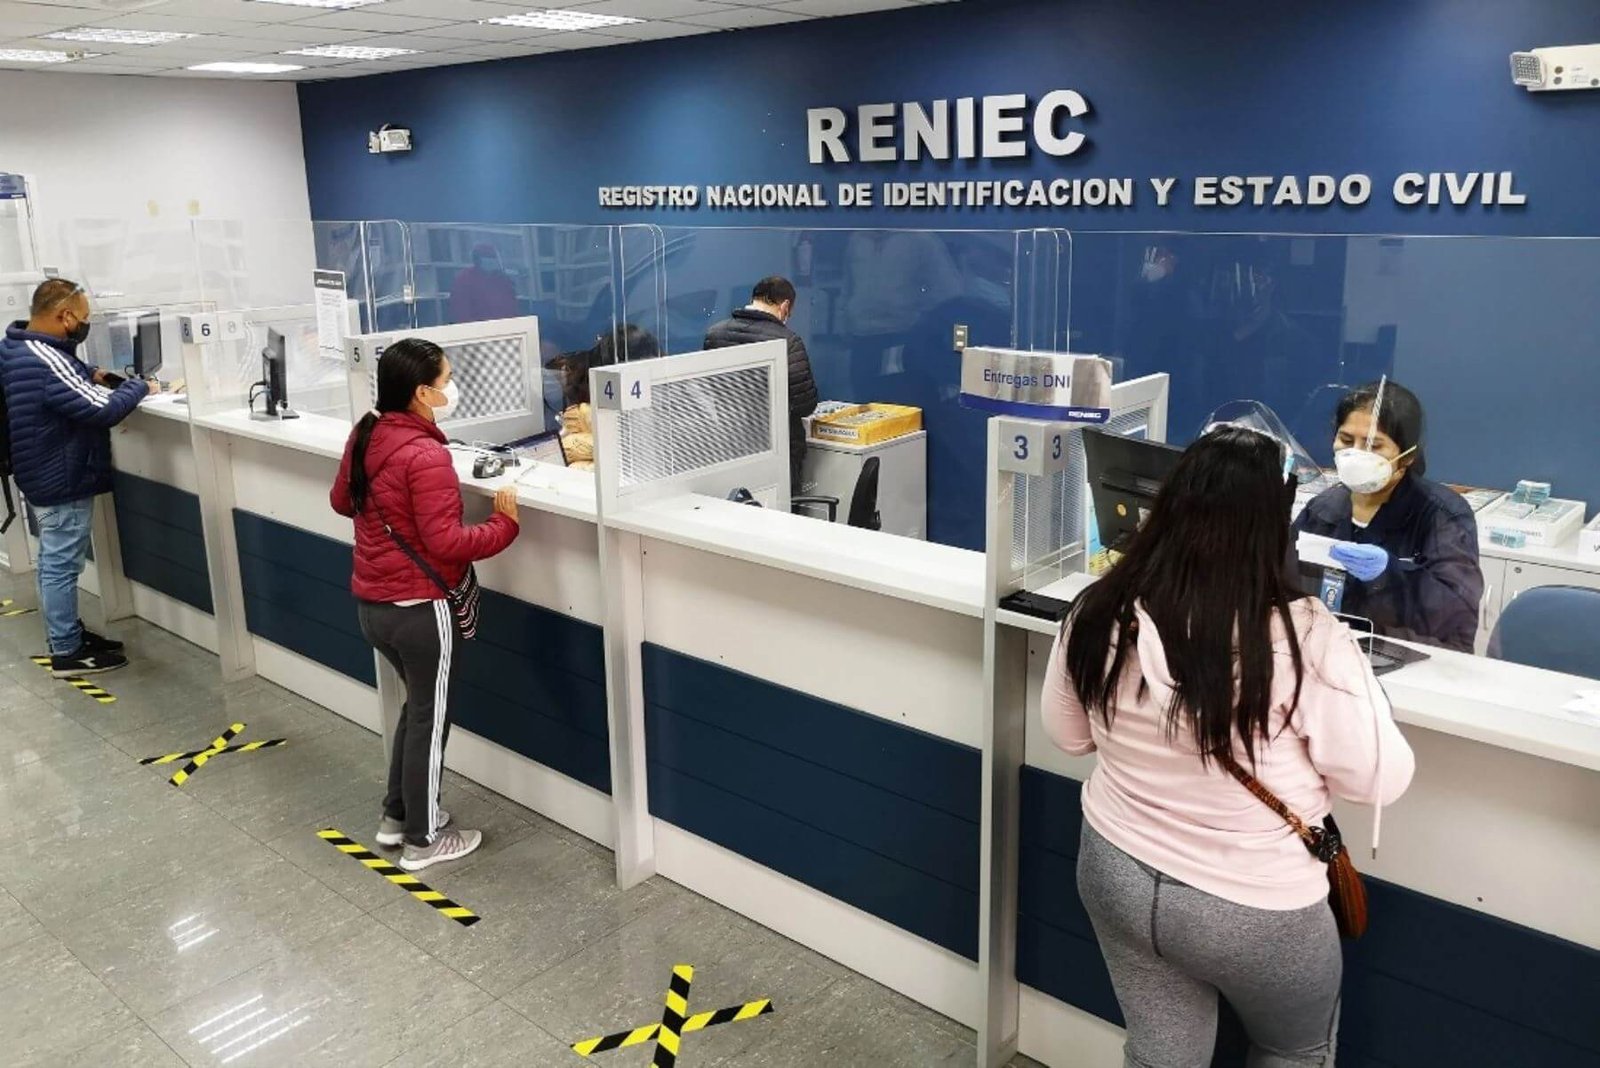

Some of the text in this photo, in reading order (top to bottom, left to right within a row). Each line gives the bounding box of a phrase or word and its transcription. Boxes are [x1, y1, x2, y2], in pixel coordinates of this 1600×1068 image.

[806, 88, 1089, 164] RENIEC
[598, 171, 1527, 207] REGISTRO NACIONAL DE IDENTIFICACION Y ESTADO CIVIL
[201, 323, 211, 337] 6
[353, 346, 361, 363] 5
[983, 368, 1071, 389] Entregas DNI
[604, 380, 614, 400] 4
[630, 380, 642, 400] 4
[1013, 435, 1029, 460] 3
[1052, 434, 1062, 460] 3
